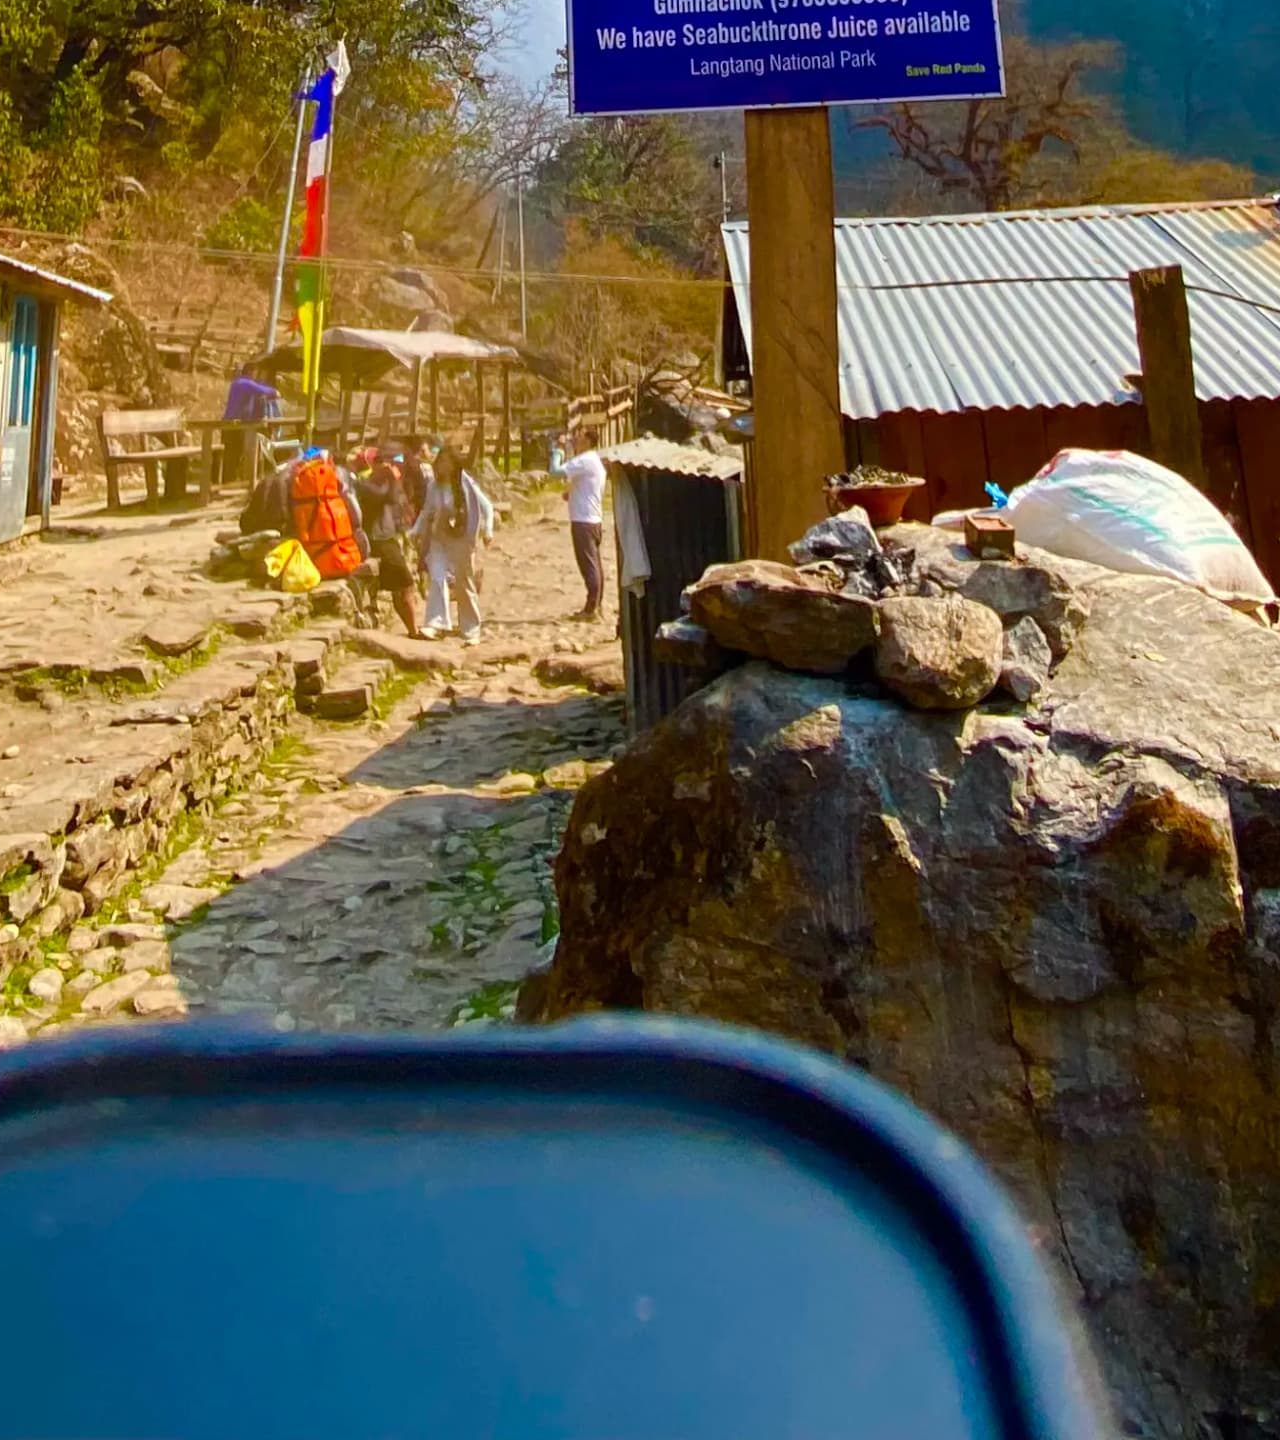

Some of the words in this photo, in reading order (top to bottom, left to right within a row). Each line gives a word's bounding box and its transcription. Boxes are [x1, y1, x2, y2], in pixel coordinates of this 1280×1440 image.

[596, 27, 627, 50] We
[632, 26, 677, 49] have
[682, 19, 821, 47] Seabuckthrone
[827, 15, 878, 39] Juice
[884, 9, 971, 36] available
[690, 57, 765, 78] Langtang
[770, 50, 835, 72] National
[840, 48, 877, 68] Park
[905, 65, 930, 77] Save
[932, 63, 952, 75] Red
[954, 61, 986, 74] Panda
